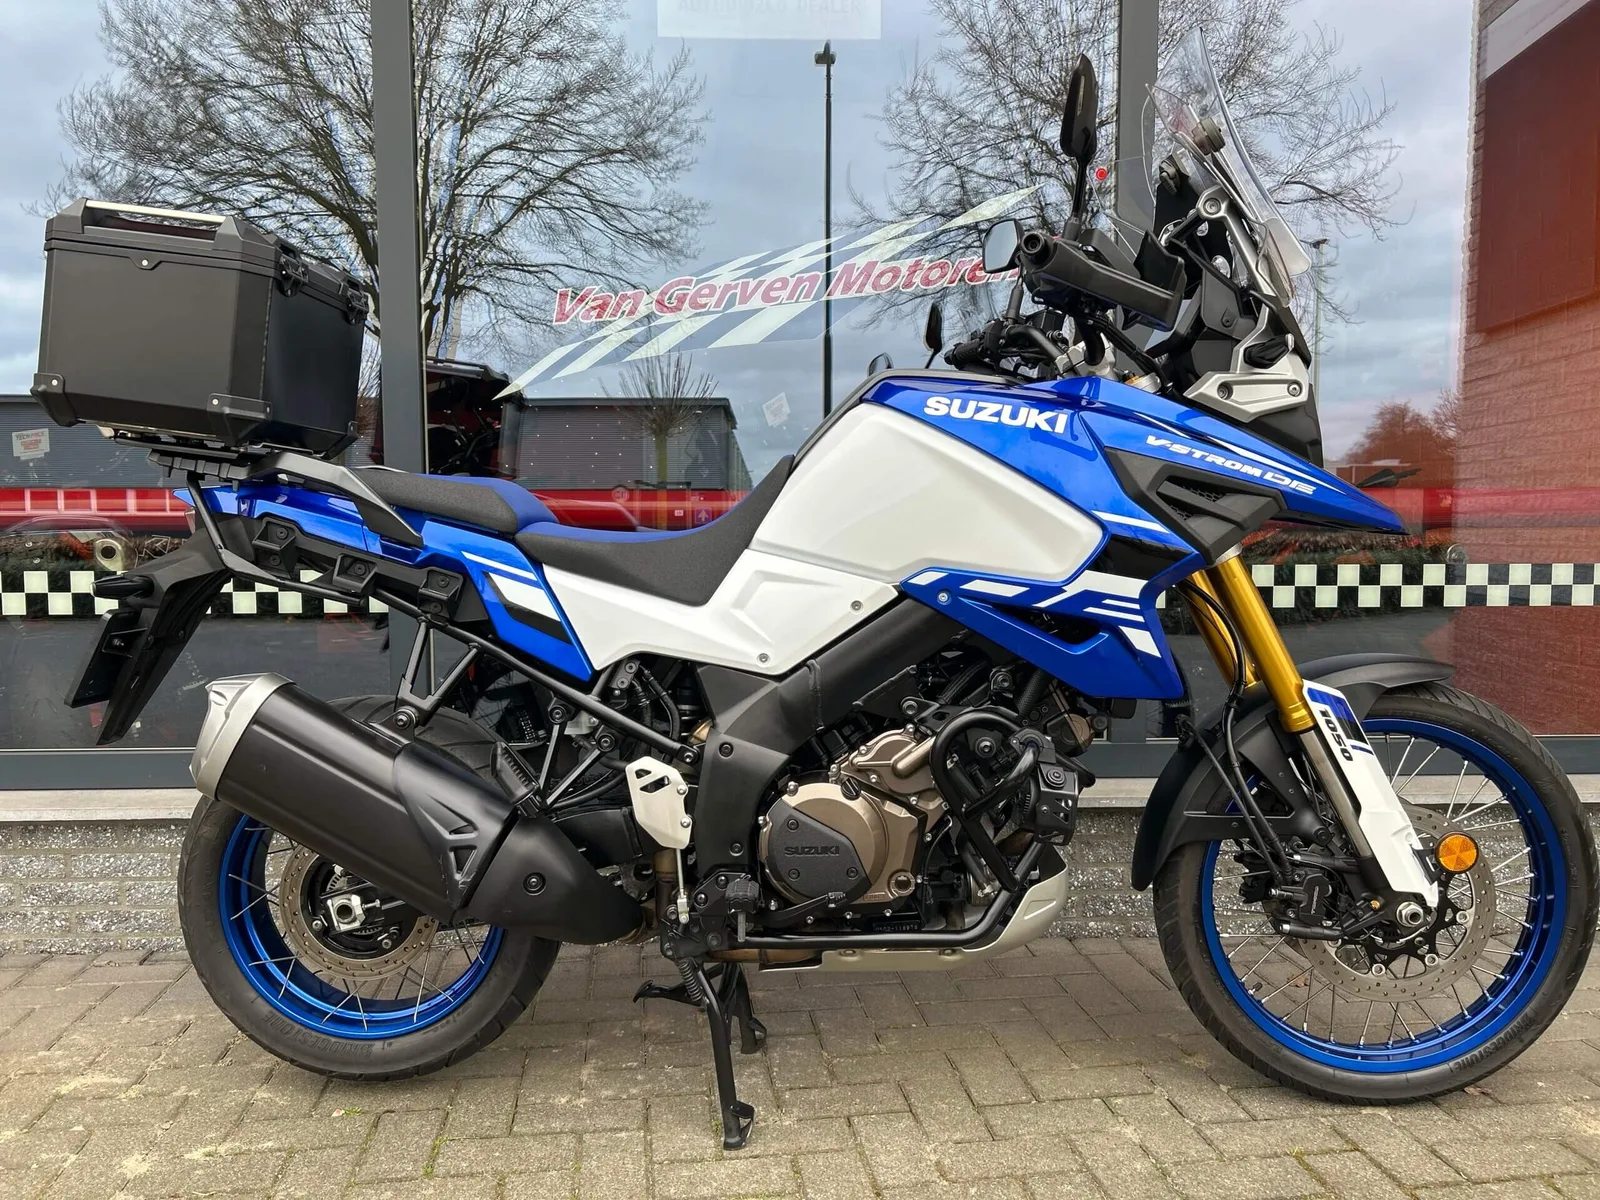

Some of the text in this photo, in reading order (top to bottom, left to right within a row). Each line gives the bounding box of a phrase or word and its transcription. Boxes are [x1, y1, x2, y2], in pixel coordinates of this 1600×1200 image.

[553, 285, 648, 325] Van
[653, 276, 824, 316] Gerven
[923, 396, 1068, 434] SUZUKI
[1146, 435, 1317, 495] V-STROM DE
[1319, 708, 1354, 762] 1050
[784, 845, 840, 857] SUZUKI
[262, 1010, 376, 1059] BRIDGESTONE
